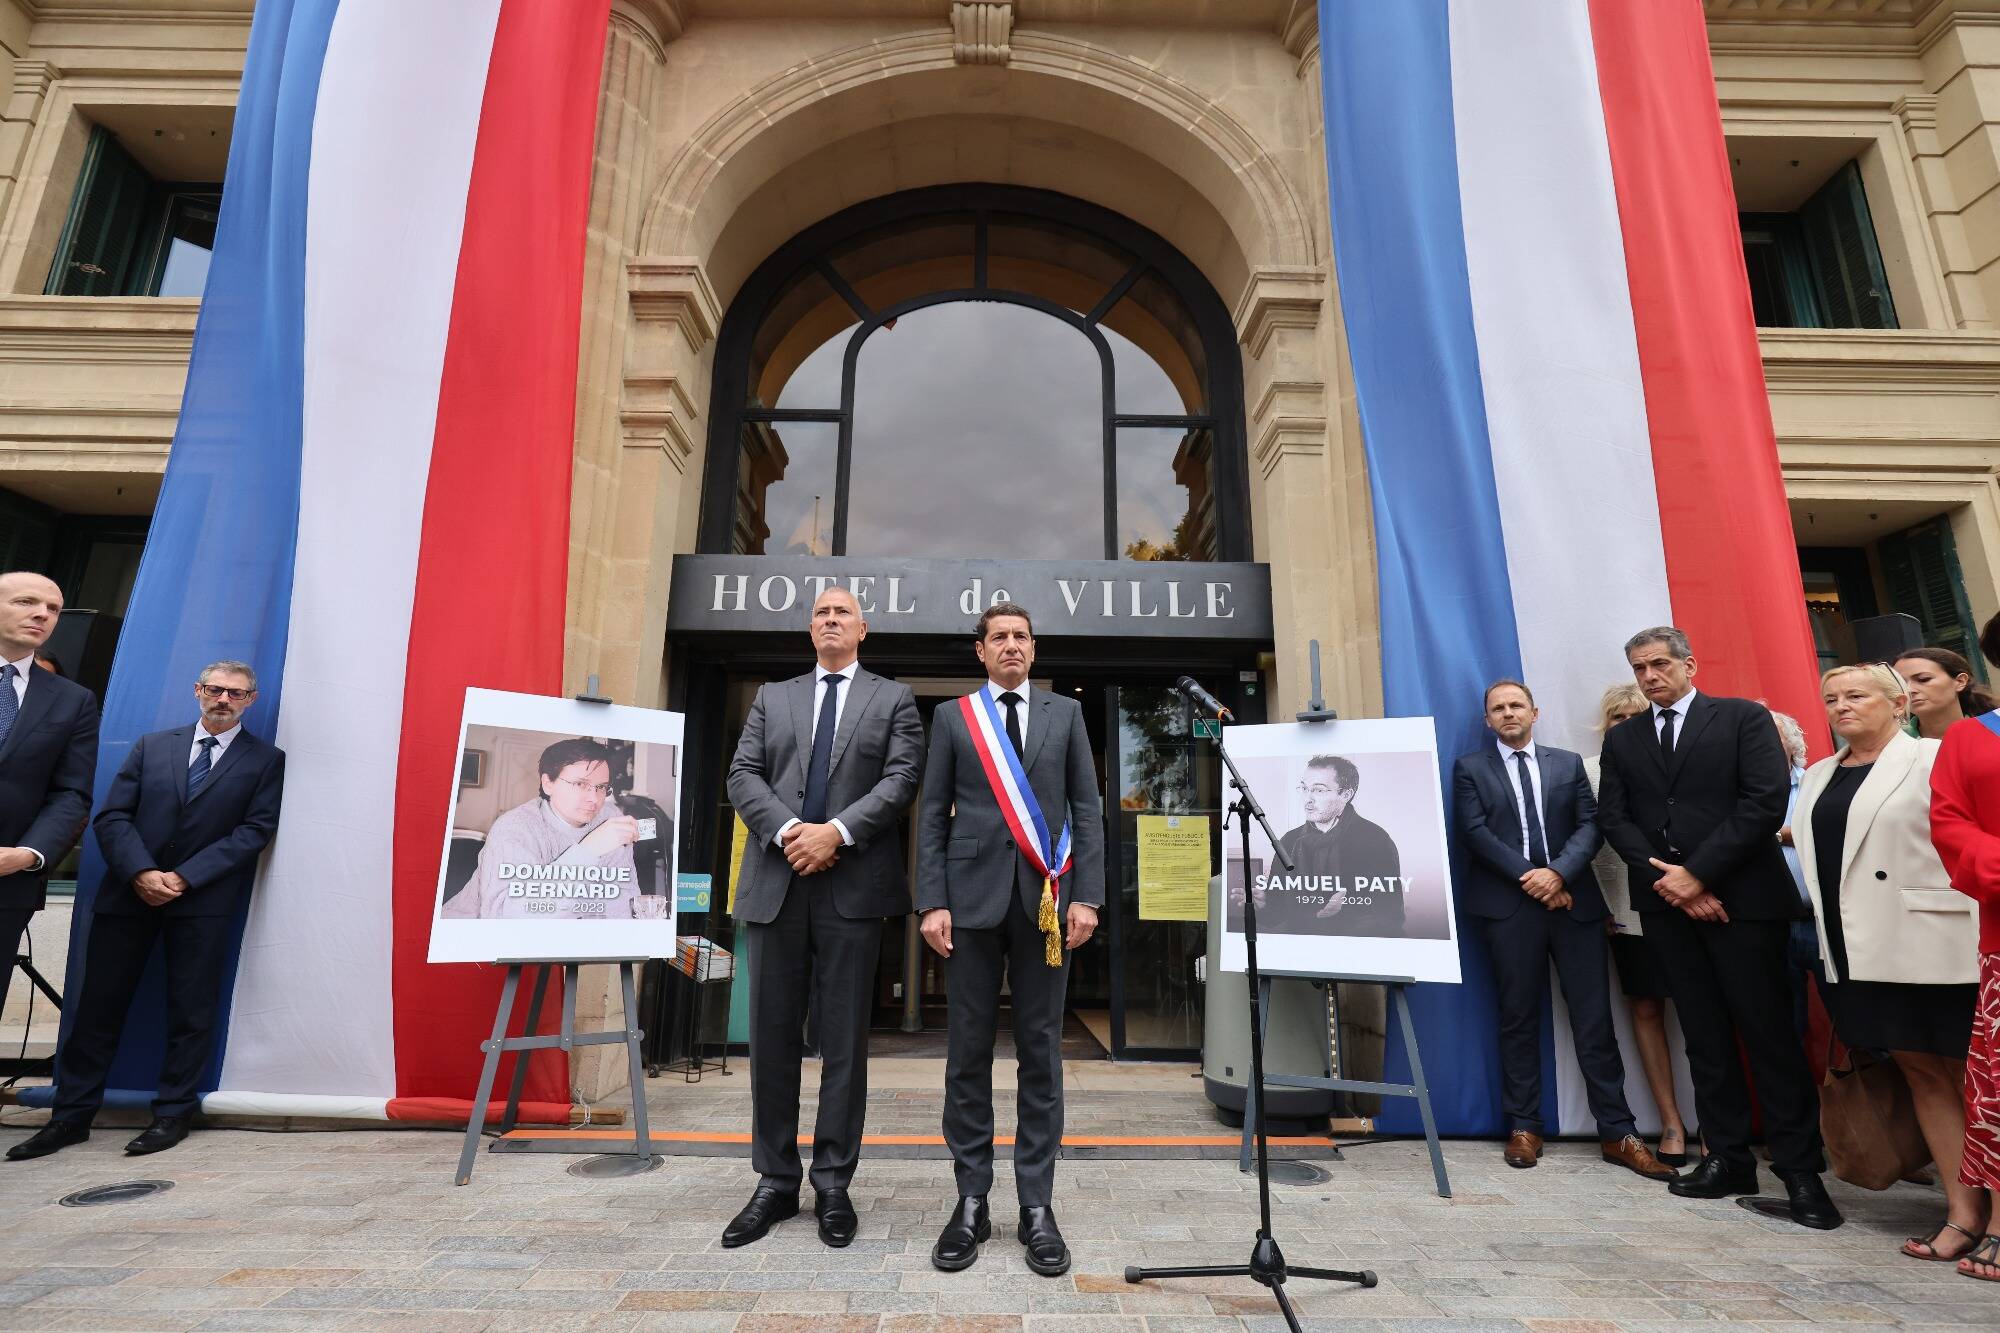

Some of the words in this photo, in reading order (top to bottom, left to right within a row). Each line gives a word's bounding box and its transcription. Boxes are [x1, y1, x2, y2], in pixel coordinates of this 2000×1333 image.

[709, 574, 916, 614] HOTEL
[959, 578, 1011, 615] de
[1055, 579, 1235, 618] VILLE
[498, 863, 631, 882] DOMINIQUE
[508, 881, 620, 899] BERNARD
[1255, 874, 1347, 892] SAMUEL
[1354, 876, 1414, 893] PATY
[523, 901, 555, 913] 1966
[572, 902, 605, 913] 2023
[1295, 895, 1325, 904] 1973
[1341, 896, 1372, 905] 2020
